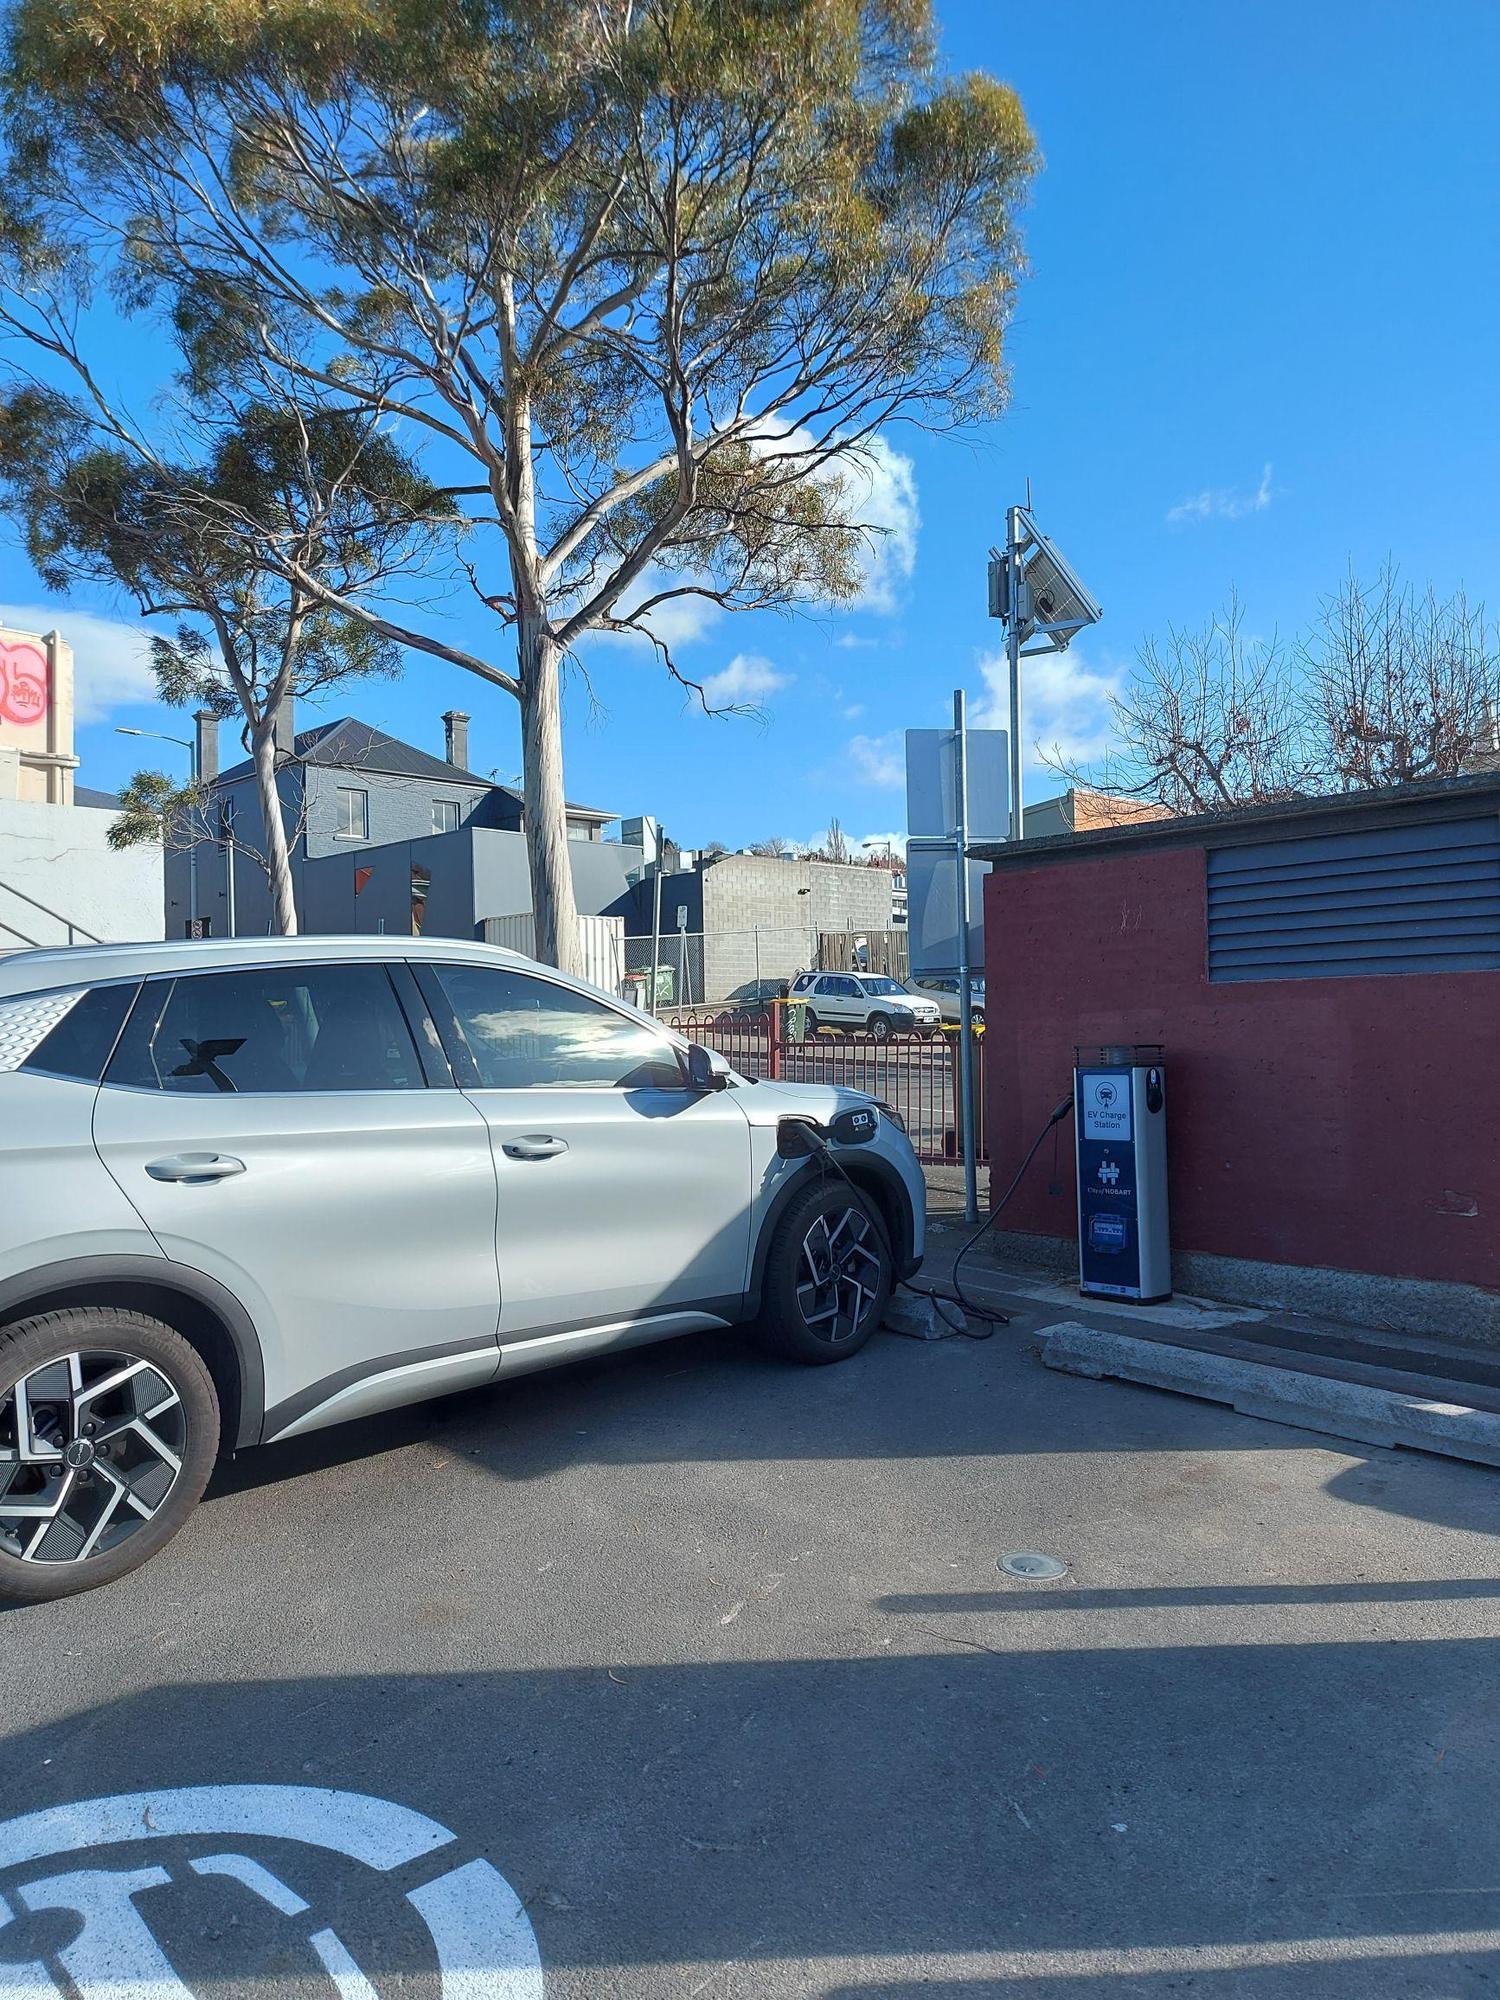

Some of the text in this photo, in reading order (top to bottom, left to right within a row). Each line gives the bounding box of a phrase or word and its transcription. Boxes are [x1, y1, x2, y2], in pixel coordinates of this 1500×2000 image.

[1087, 1111, 1127, 1121] EV Charge
[1094, 1120, 1121, 1129] Station
